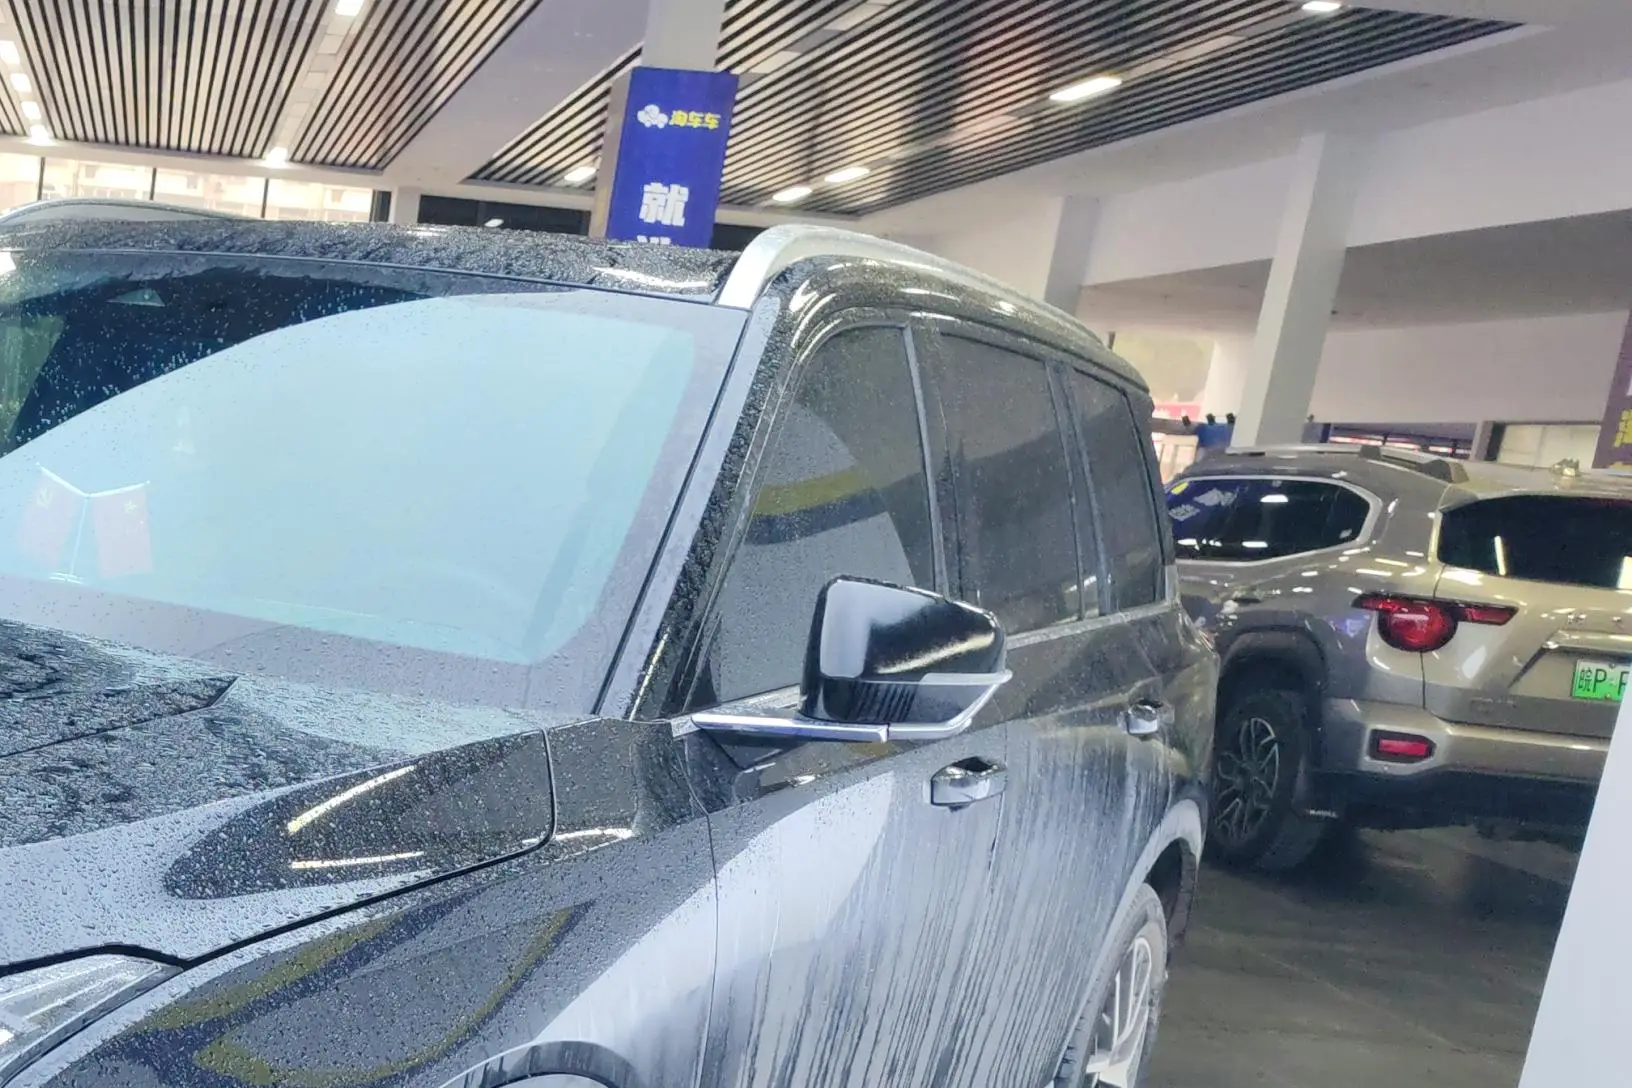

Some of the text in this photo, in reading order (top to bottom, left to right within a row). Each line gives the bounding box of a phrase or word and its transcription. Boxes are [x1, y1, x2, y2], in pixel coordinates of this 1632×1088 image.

[669, 109, 721, 130] 淘车车
[639, 182, 690, 227] 就
